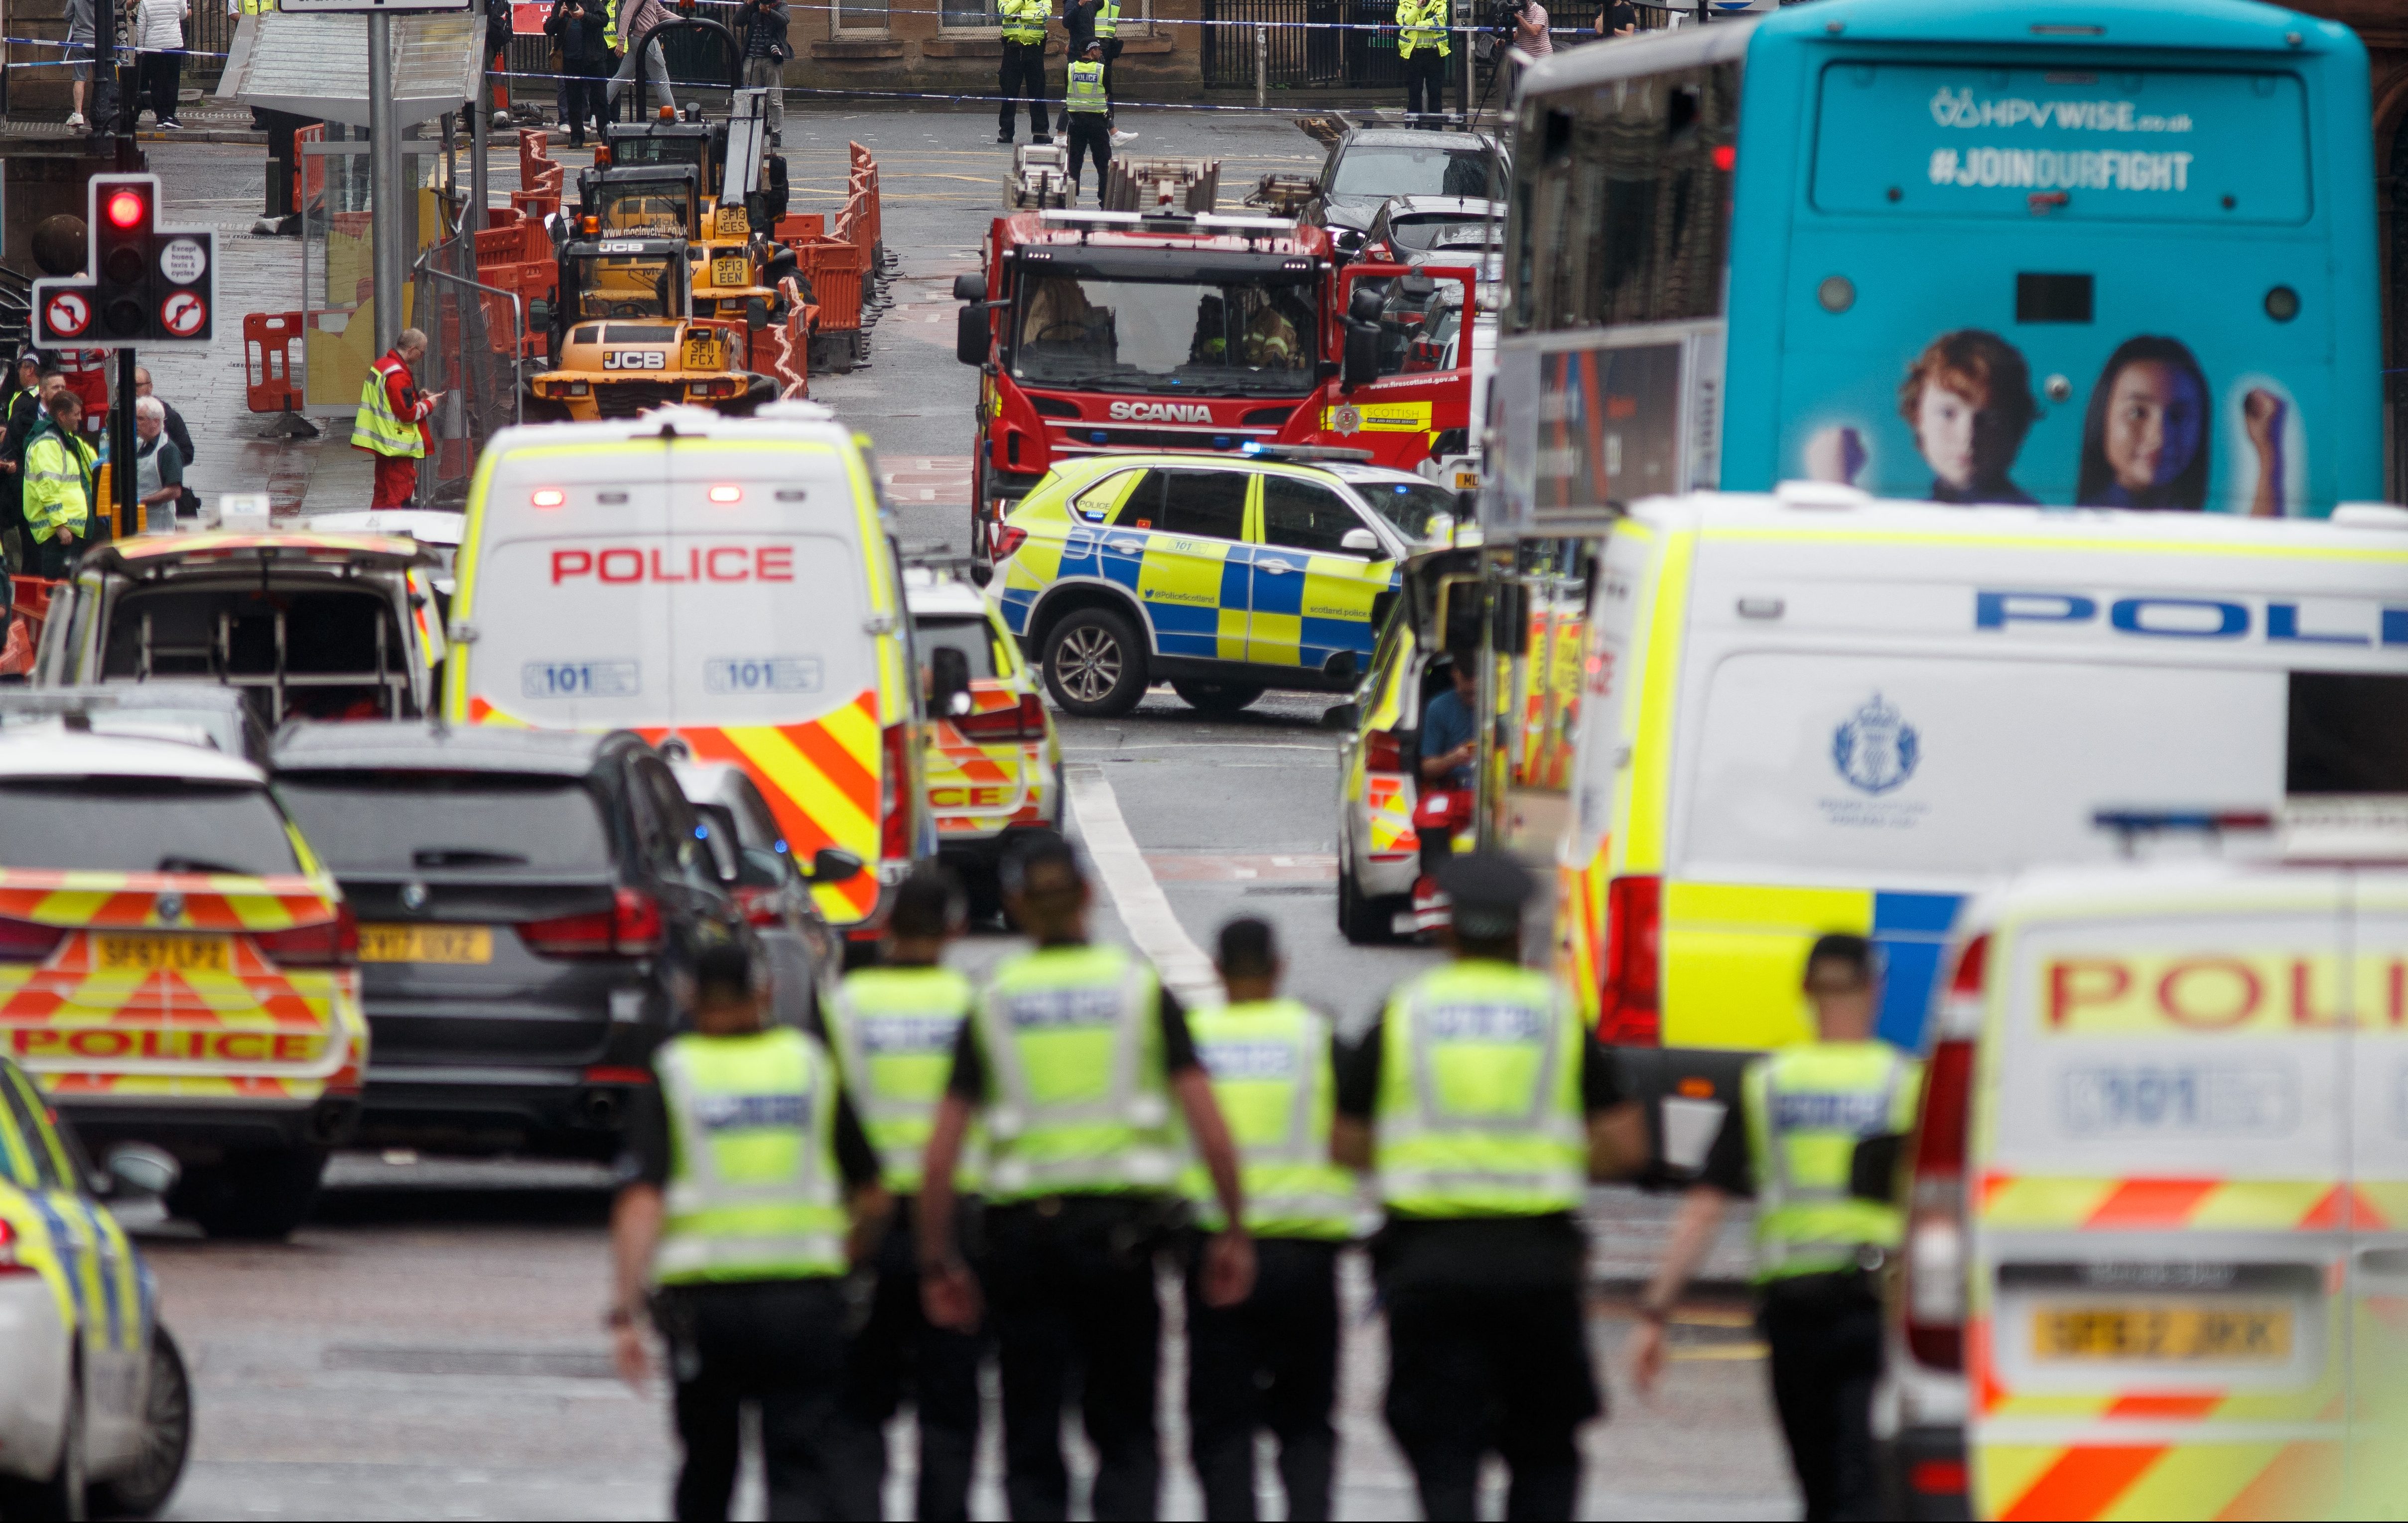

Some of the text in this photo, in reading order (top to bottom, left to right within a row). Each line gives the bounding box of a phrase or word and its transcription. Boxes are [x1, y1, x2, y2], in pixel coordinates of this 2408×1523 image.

[1930, 147, 2193, 191] #JOINOURFIGHT
[722, 209, 745, 221] SF13
[723, 221, 745, 232] EES
[599, 244, 643, 252] JCB
[717, 260, 743, 271] SF13
[719, 272, 742, 283] EEN
[691, 342, 714, 353] SF11
[604, 352, 665, 369] JCB
[690, 354, 714, 366] FCX
[1370, 375, 1459, 389] www.firescotland.gov.uk
[1109, 402, 1213, 423] SCANIA
[1367, 408, 1419, 418] SCOTTISH
[1079, 501, 1111, 510] POLICE
[1176, 541, 1192, 551] 101
[550, 546, 795, 586] POLICE
[1155, 591, 1215, 603] @PoliceScotland
[1310, 606, 1373, 617] scotland.police.
[545, 666, 593, 693] 101
[729, 663, 776, 689] 101
[13, 1029, 308, 1060] POLICE
